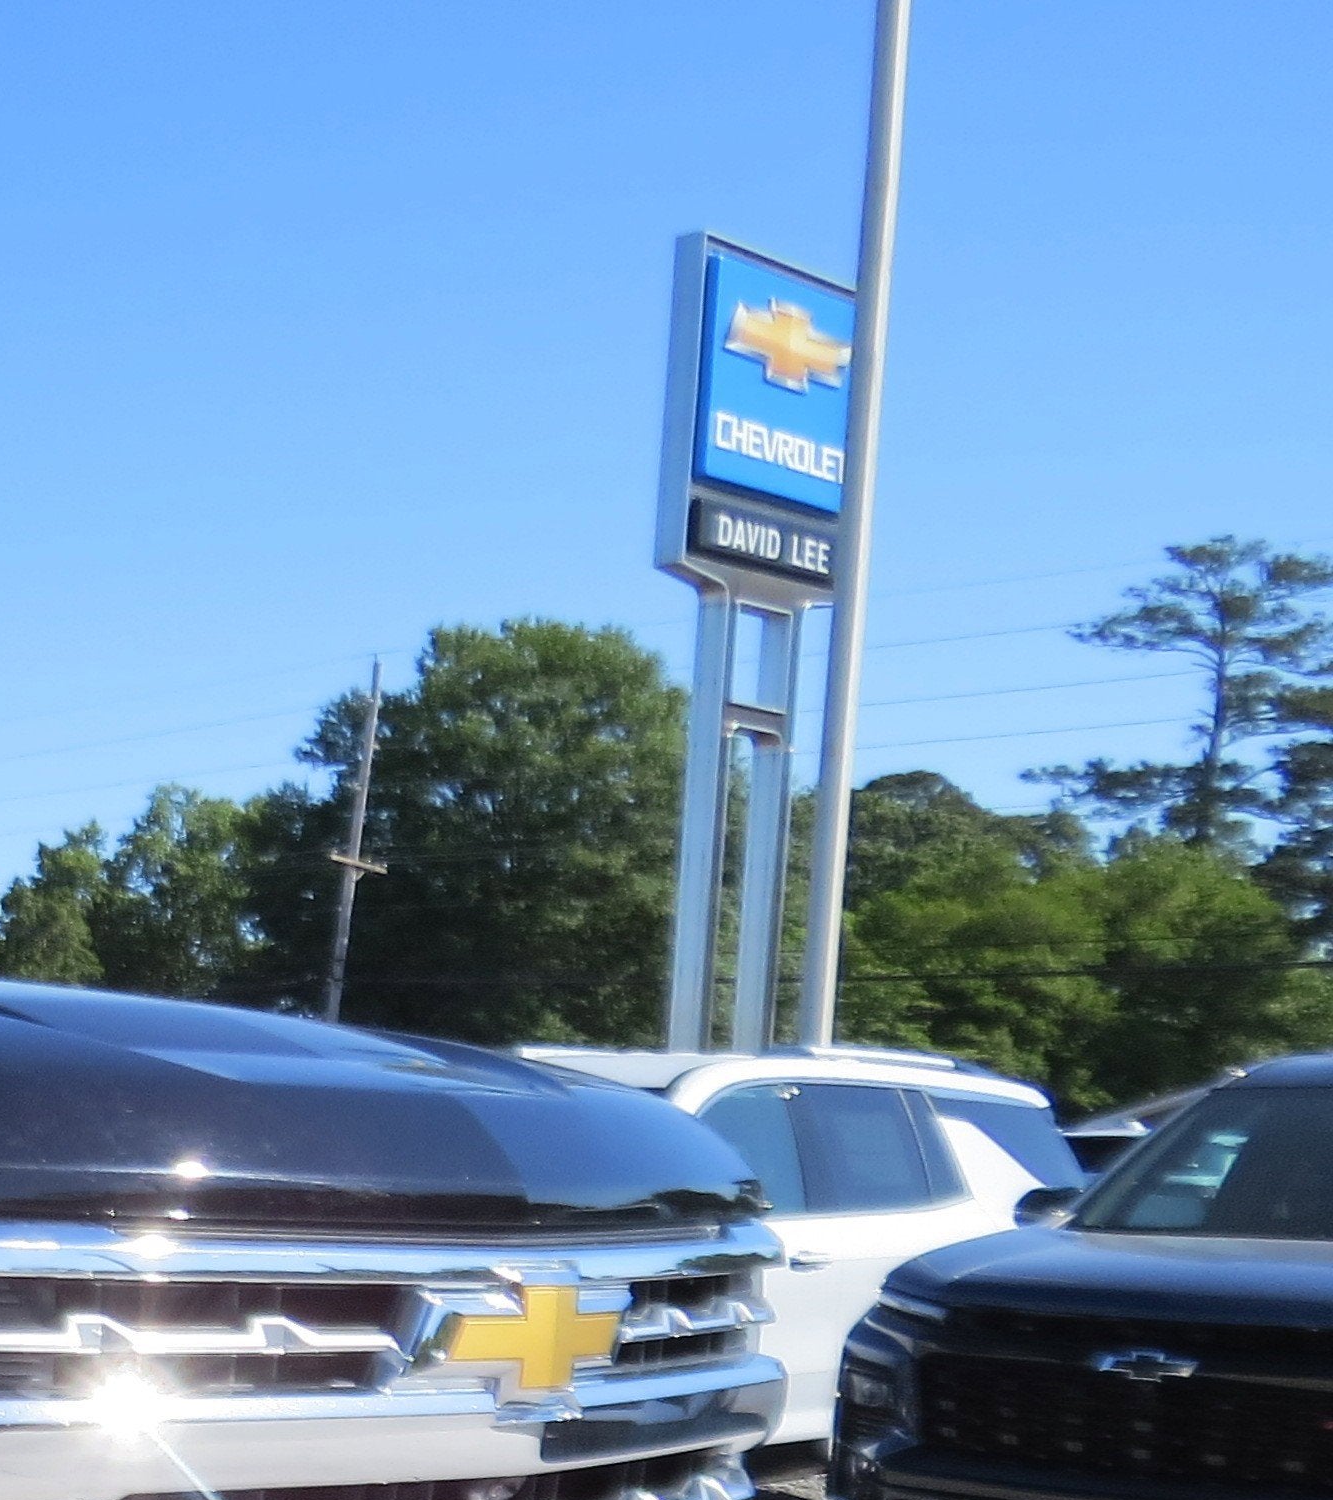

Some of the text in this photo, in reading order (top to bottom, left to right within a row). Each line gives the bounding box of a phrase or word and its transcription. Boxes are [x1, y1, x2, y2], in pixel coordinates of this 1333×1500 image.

[716, 411, 845, 485] CHEVROLET
[717, 513, 832, 575] DAVID LEE
